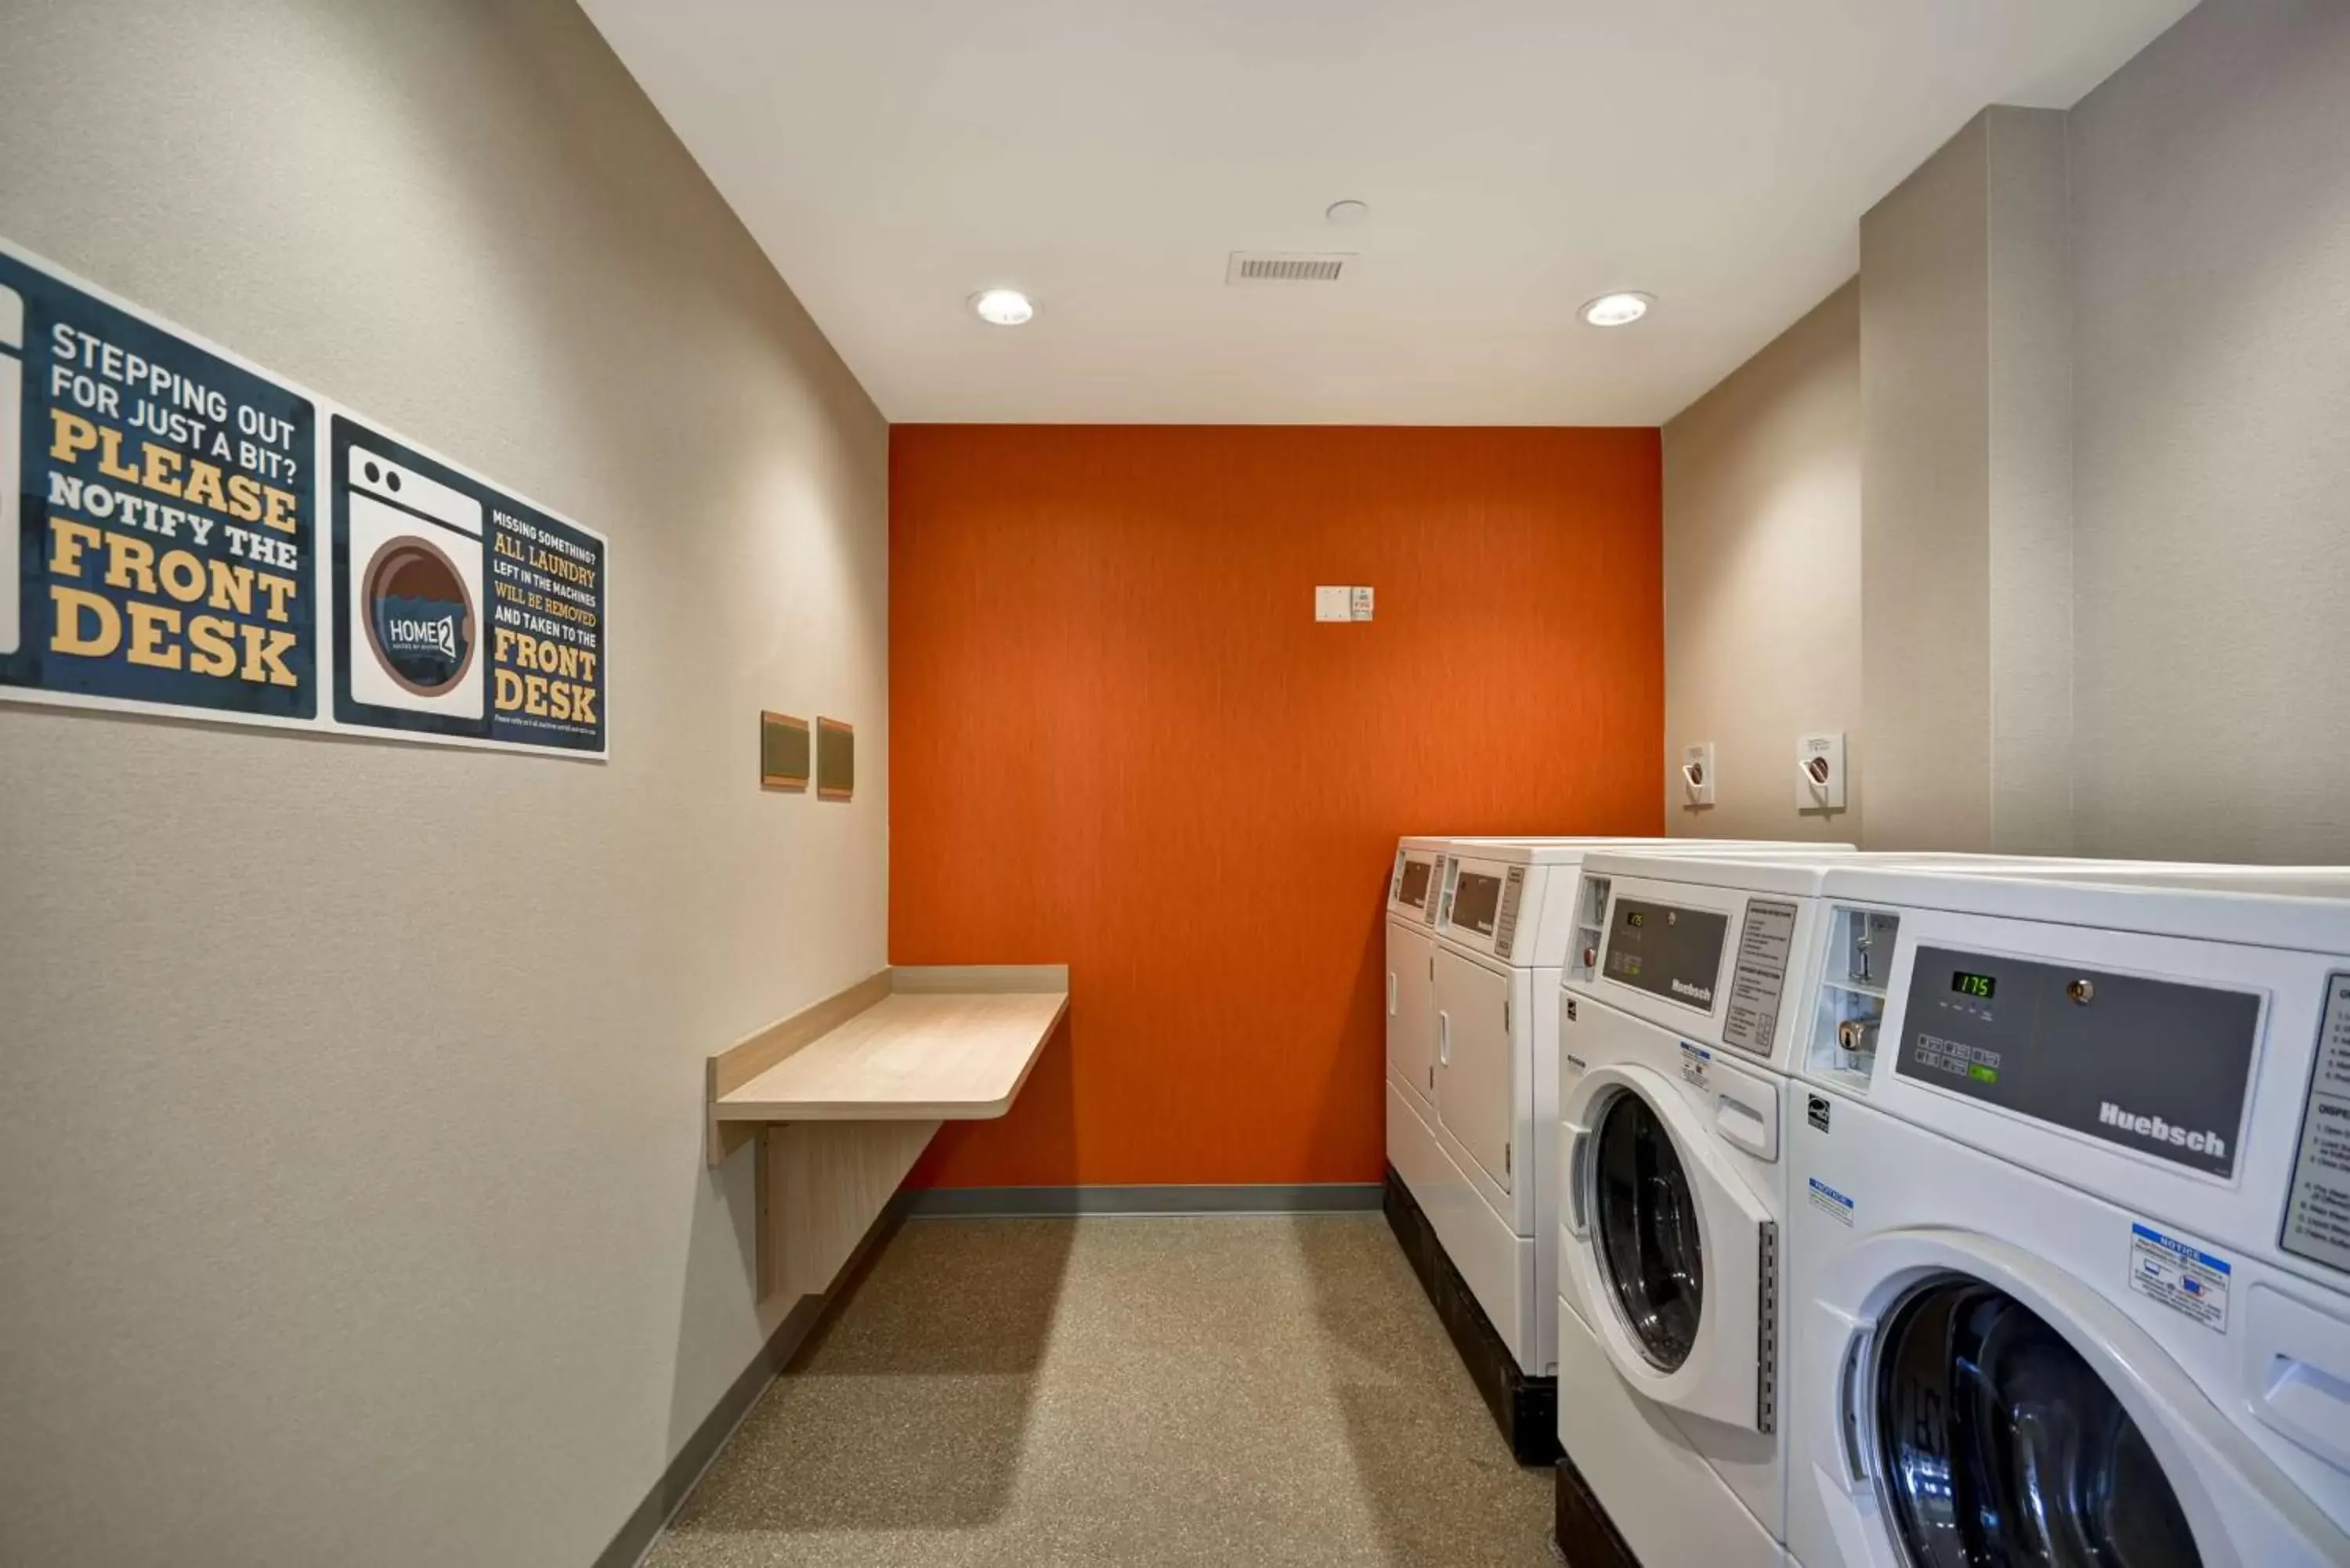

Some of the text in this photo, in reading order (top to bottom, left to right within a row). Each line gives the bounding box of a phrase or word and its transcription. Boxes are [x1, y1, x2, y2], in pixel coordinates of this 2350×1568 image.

[52, 323, 295, 450] STEPPING OUT
[51, 364, 297, 484] FOR JUST A BIT?
[49, 407, 296, 534] PLEASE
[48, 471, 298, 570] NOTIFY THE
[493, 509, 596, 565] MISSING SOMETHING?
[49, 516, 296, 623] FRONT
[494, 532, 595, 588] ALL LAUNDRY
[494, 558, 596, 608] LEFT IN THE MACHINES
[494, 580, 596, 627] WILL BE REMOVED
[494, 604, 596, 648] AND TAKEN TO THE
[49, 584, 298, 687] DESK
[494, 627, 596, 683] FRONT
[494, 667, 596, 724] DESK
[1671, 977, 1712, 1002] Huebsch
[1961, 975, 1990, 995] 175
[2099, 1100, 2225, 1158] Huebsch
[2160, 1235, 2201, 1261] NOTICE
